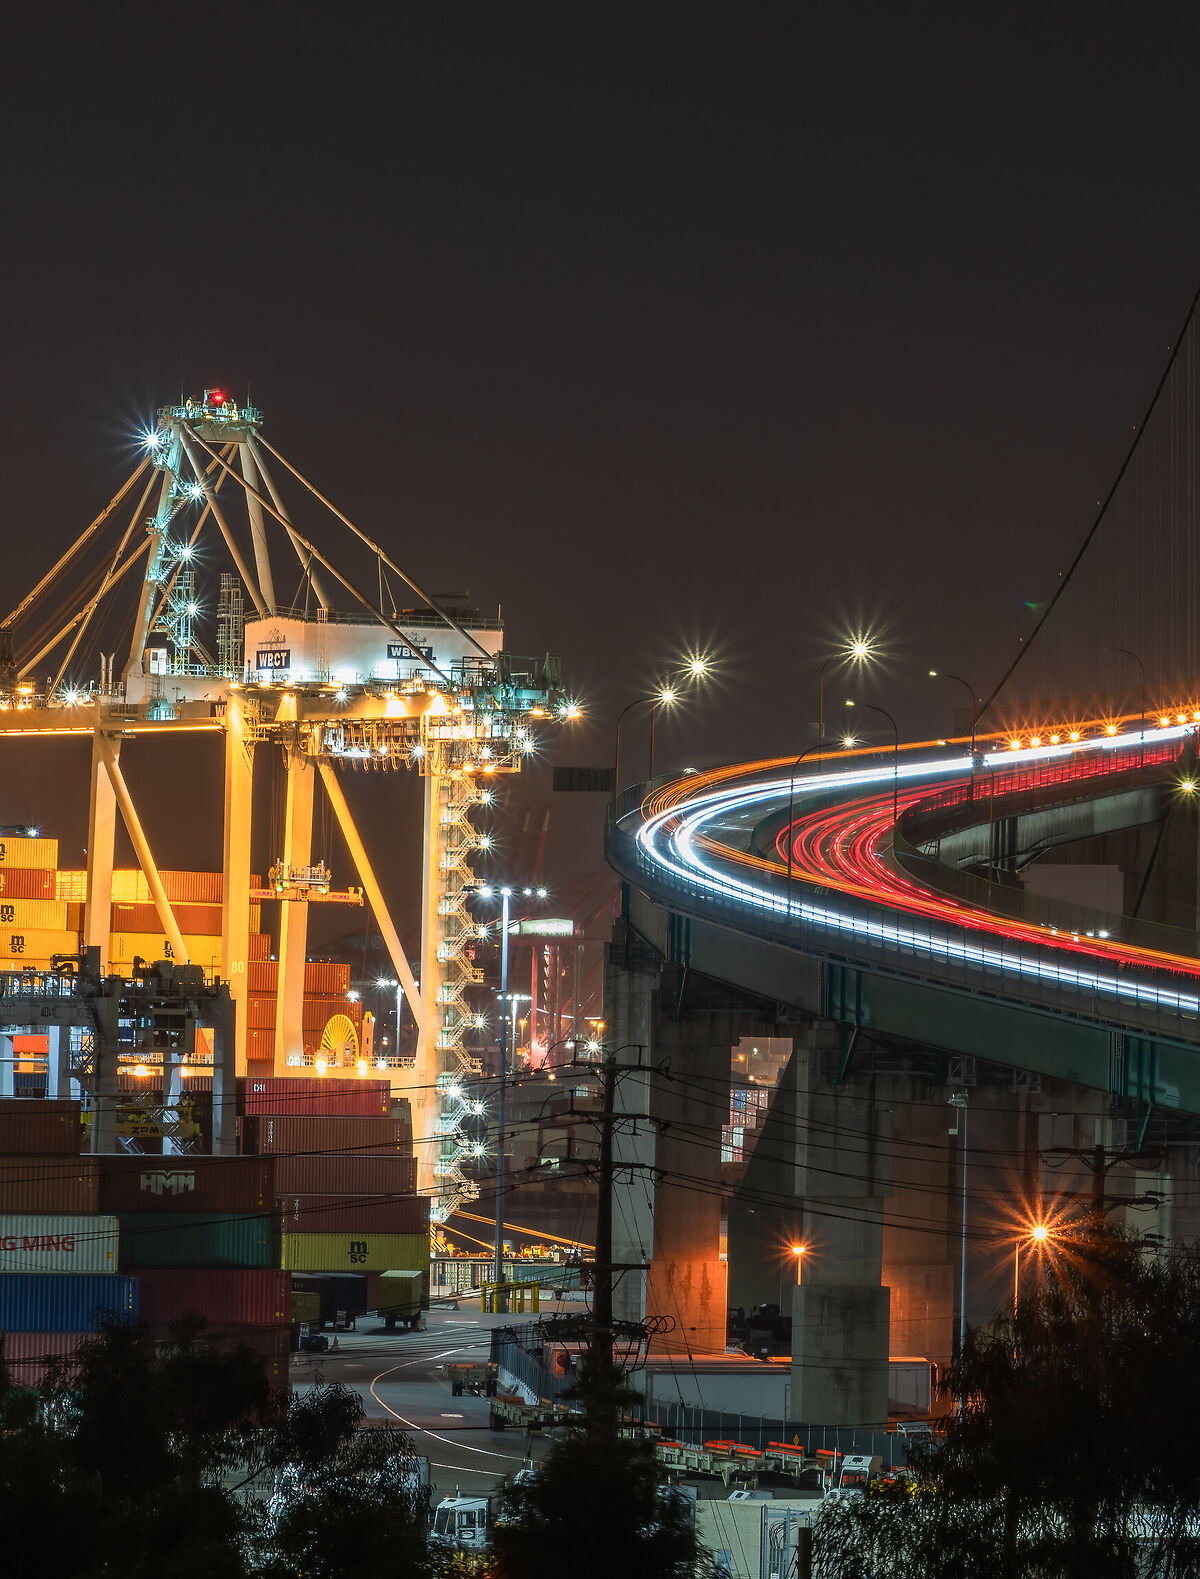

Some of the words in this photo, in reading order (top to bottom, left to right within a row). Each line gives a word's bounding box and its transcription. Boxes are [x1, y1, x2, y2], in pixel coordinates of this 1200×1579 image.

[259, 652, 287, 667] WBCT
[232, 961, 244, 973] 80
[131, 1126, 163, 1134] ZPM
[140, 1170, 195, 1196] HMM
[23, 1235, 75, 1252] MING
